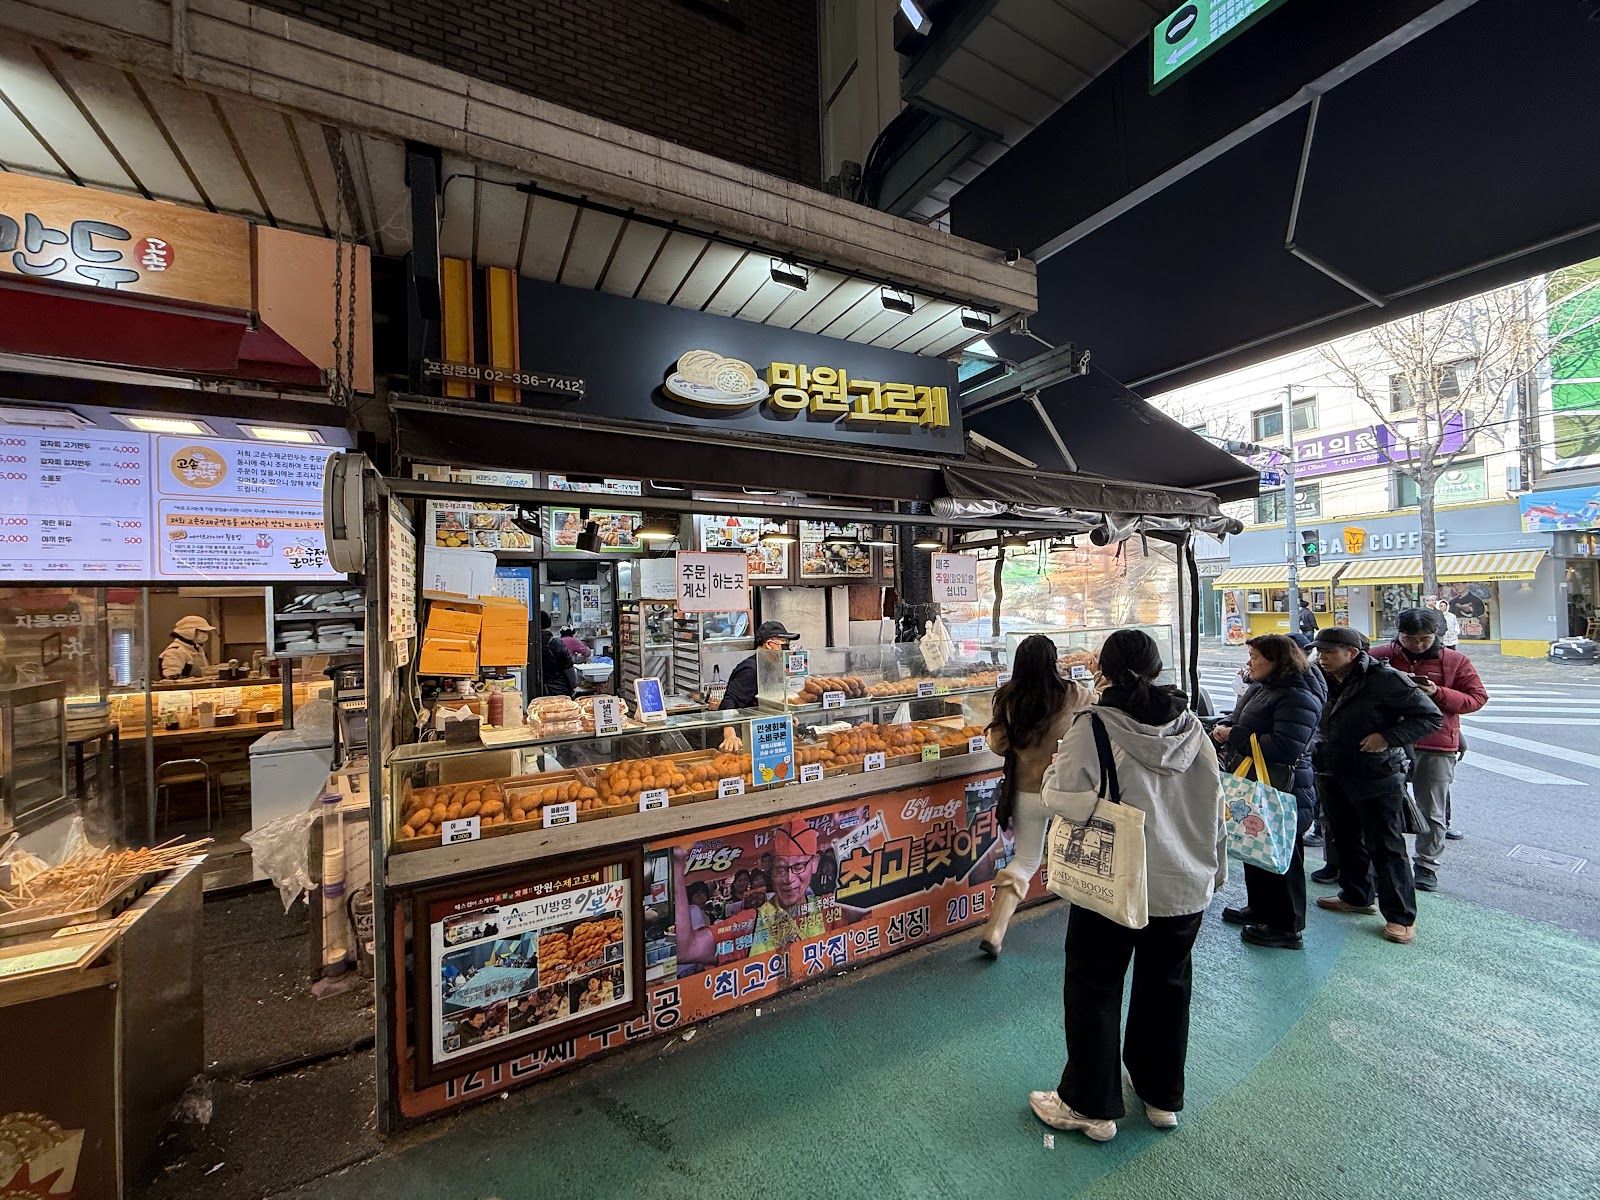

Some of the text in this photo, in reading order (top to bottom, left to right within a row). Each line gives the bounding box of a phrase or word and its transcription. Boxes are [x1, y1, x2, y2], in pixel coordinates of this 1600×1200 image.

[428, 361, 580, 392] 포장문의 02-336-7412
[766, 361, 950, 430] 망원고로케
[63, 441, 91, 450] 고기만두
[113, 445, 140, 454] 4,000
[113, 462, 140, 470] 4,000
[237, 459, 258, 467] 동시에
[275, 462, 301, 470] 조리하여
[237, 468, 258, 476] 주문이
[114, 478, 140, 486] 4,000
[116, 520, 142, 529] 1,000
[1369, 528, 1448, 552] COFFE
[935, 559, 950, 570] 매주
[683, 564, 744, 590] 주문 하는곳
[682, 583, 707, 598] 계산
[946, 586, 968, 597] 쉽니다
[757, 722, 787, 734] 민생회복
[758, 732, 787, 743] 소비쿠폰
[917, 798, 964, 824] 내고향
[533, 871, 600, 896] 망원수제고로케
[1081, 880, 1114, 898] BOOKS
[575, 884, 613, 913] 아빠
[586, 885, 624, 917] 본색
[825, 906, 842, 923] 상인
[885, 906, 931, 946] 선정!
[715, 940, 734, 957] 서울
